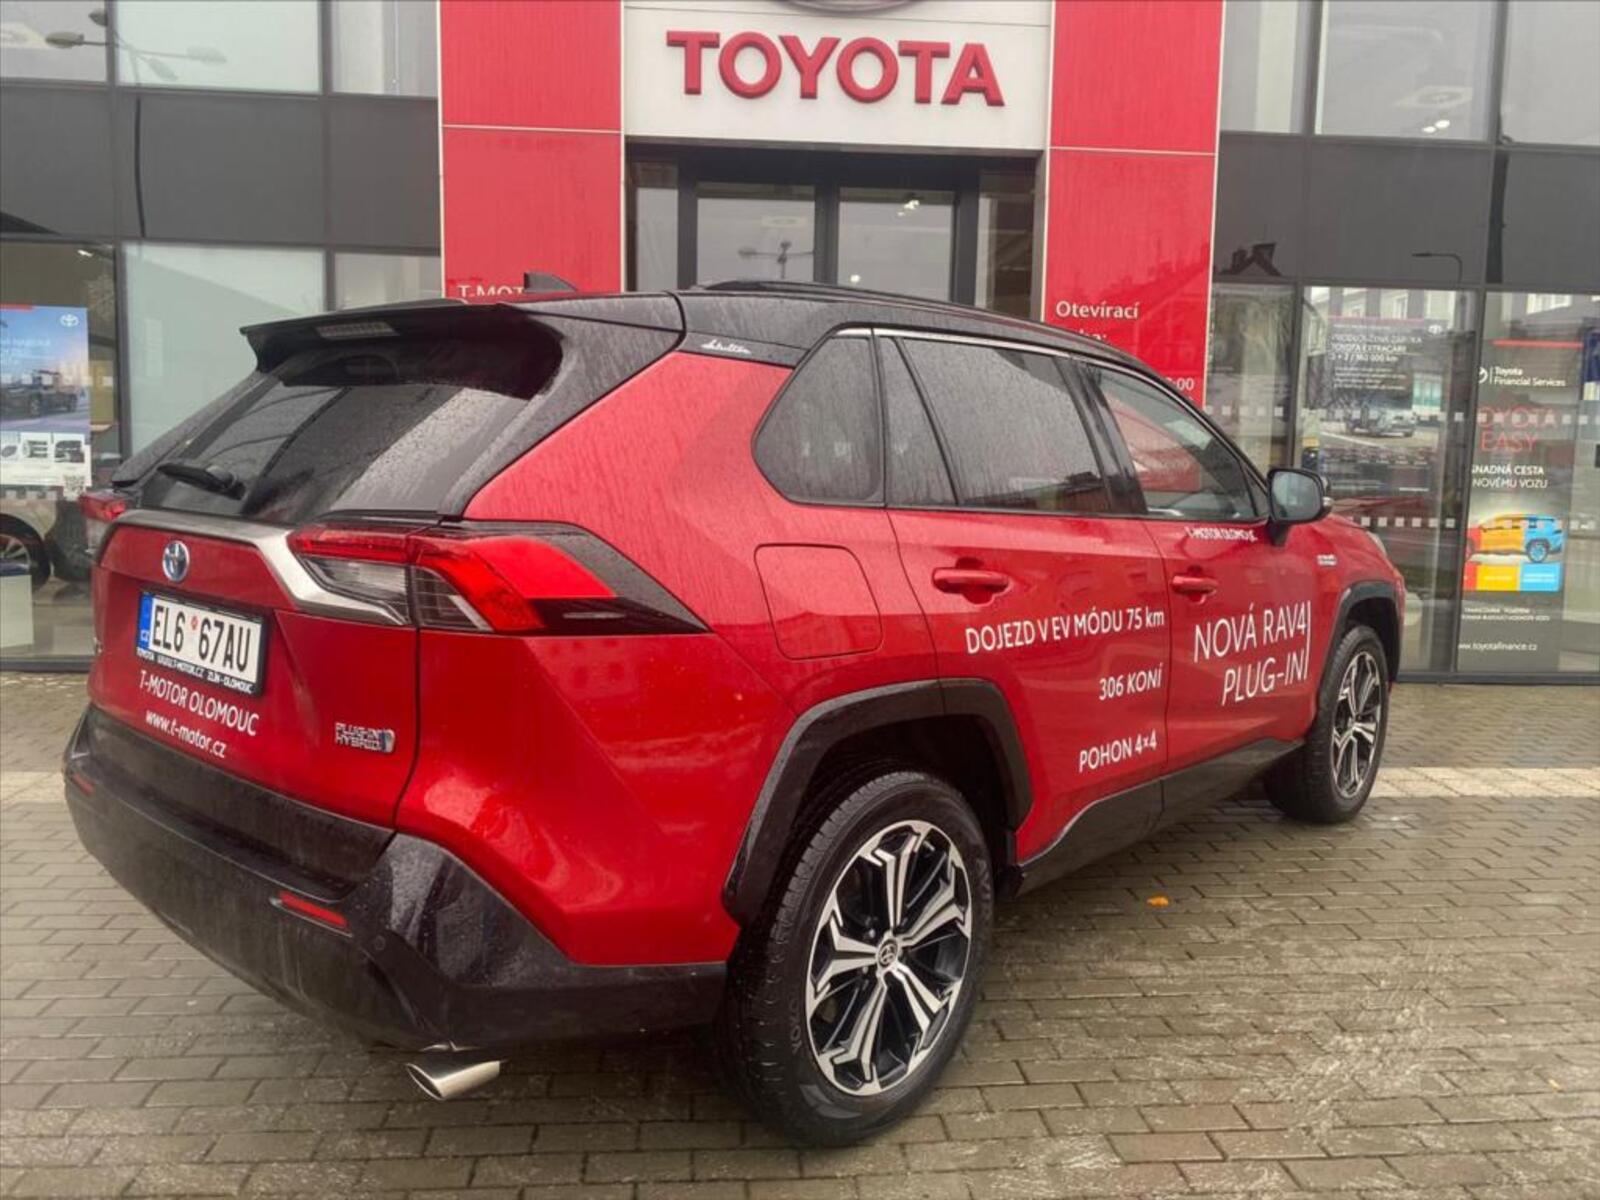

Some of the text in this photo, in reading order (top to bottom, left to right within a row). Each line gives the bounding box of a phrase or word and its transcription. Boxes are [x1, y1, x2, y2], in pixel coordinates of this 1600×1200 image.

[666, 30, 1005, 107] TOYOTA
[1056, 300, 1139, 319] Otevírací
[1494, 366, 1523, 377] Toyota
[1494, 377, 1566, 387] Financial Services
[1476, 404, 1559, 429] OYOTA
[1480, 430, 1539, 453] EASY
[1472, 476, 1548, 489] NOVÉMU VOZU
[1514, 465, 1545, 475] CESTA
[152, 604, 251, 673] EL6 67AU
[965, 606, 1165, 654] DOJEZD V EV MÓDU 75 km
[1194, 601, 1307, 663] NOVÁ RAV4
[1099, 662, 1164, 700] 306 KONÍ
[1221, 648, 1305, 706] PLUG-IN
[140, 669, 260, 737] T-MOTOR OLOMOUC
[145, 709, 227, 758] www.t-motor.cz
[1079, 737, 1133, 773] POHON
